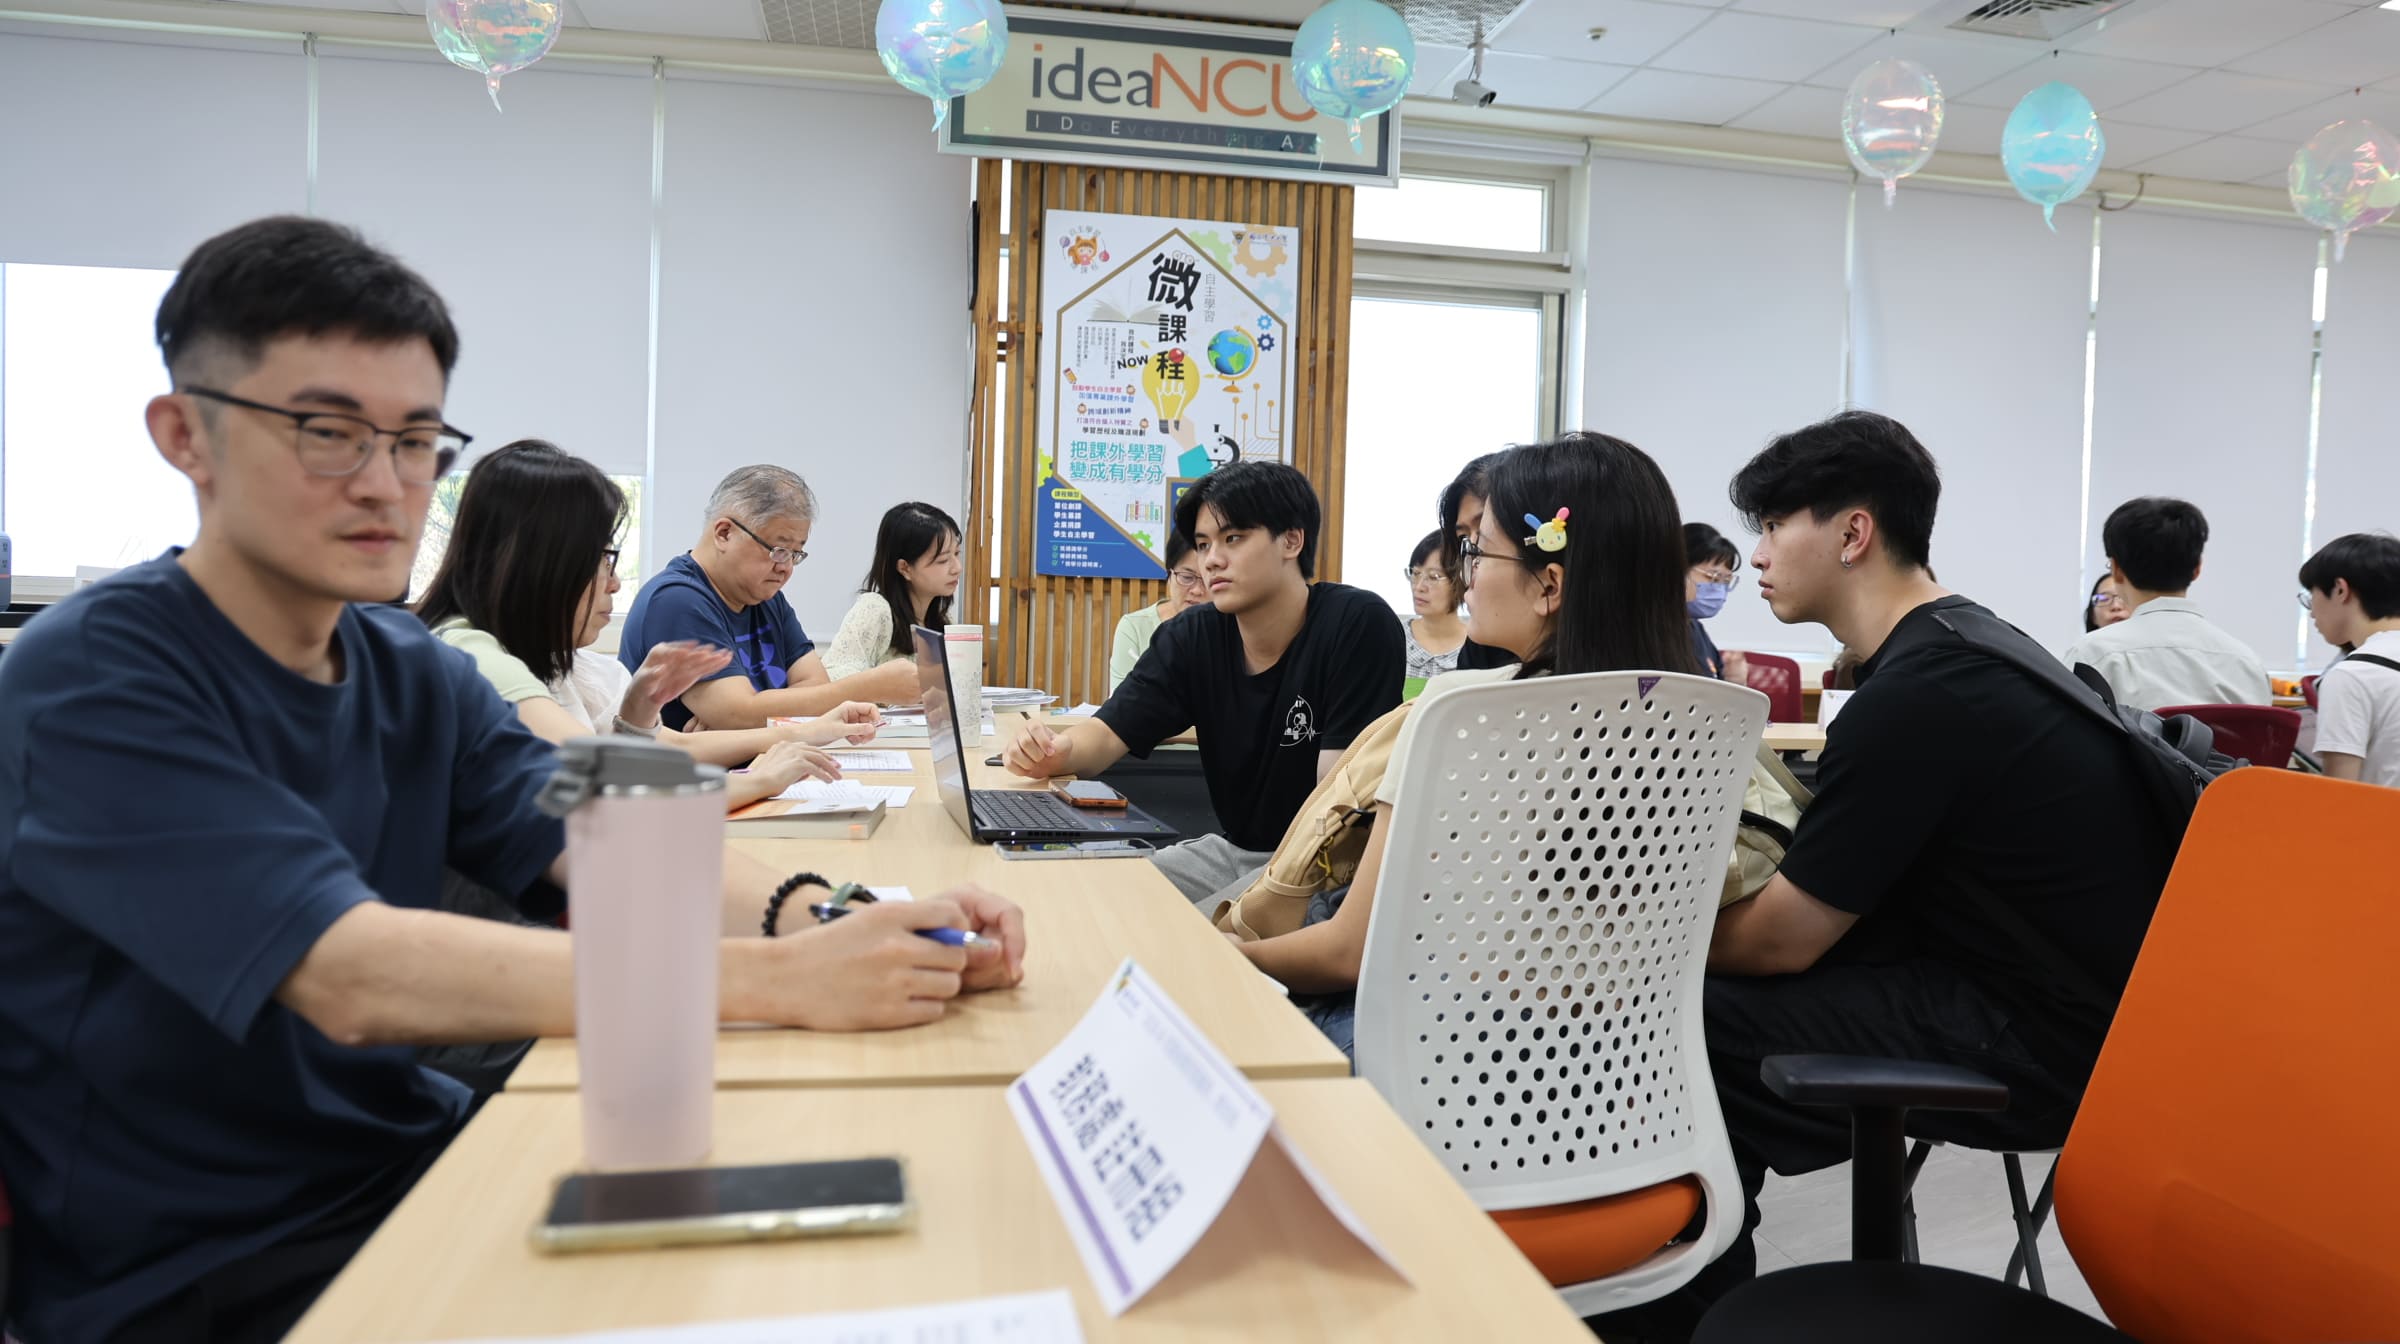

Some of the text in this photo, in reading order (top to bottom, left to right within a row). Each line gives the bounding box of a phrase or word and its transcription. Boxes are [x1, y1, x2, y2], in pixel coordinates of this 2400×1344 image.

[1117, 354, 1149, 370] NOW
[1070, 440, 1164, 463] 把課外學習
[1070, 461, 1163, 482] 變成有學分
